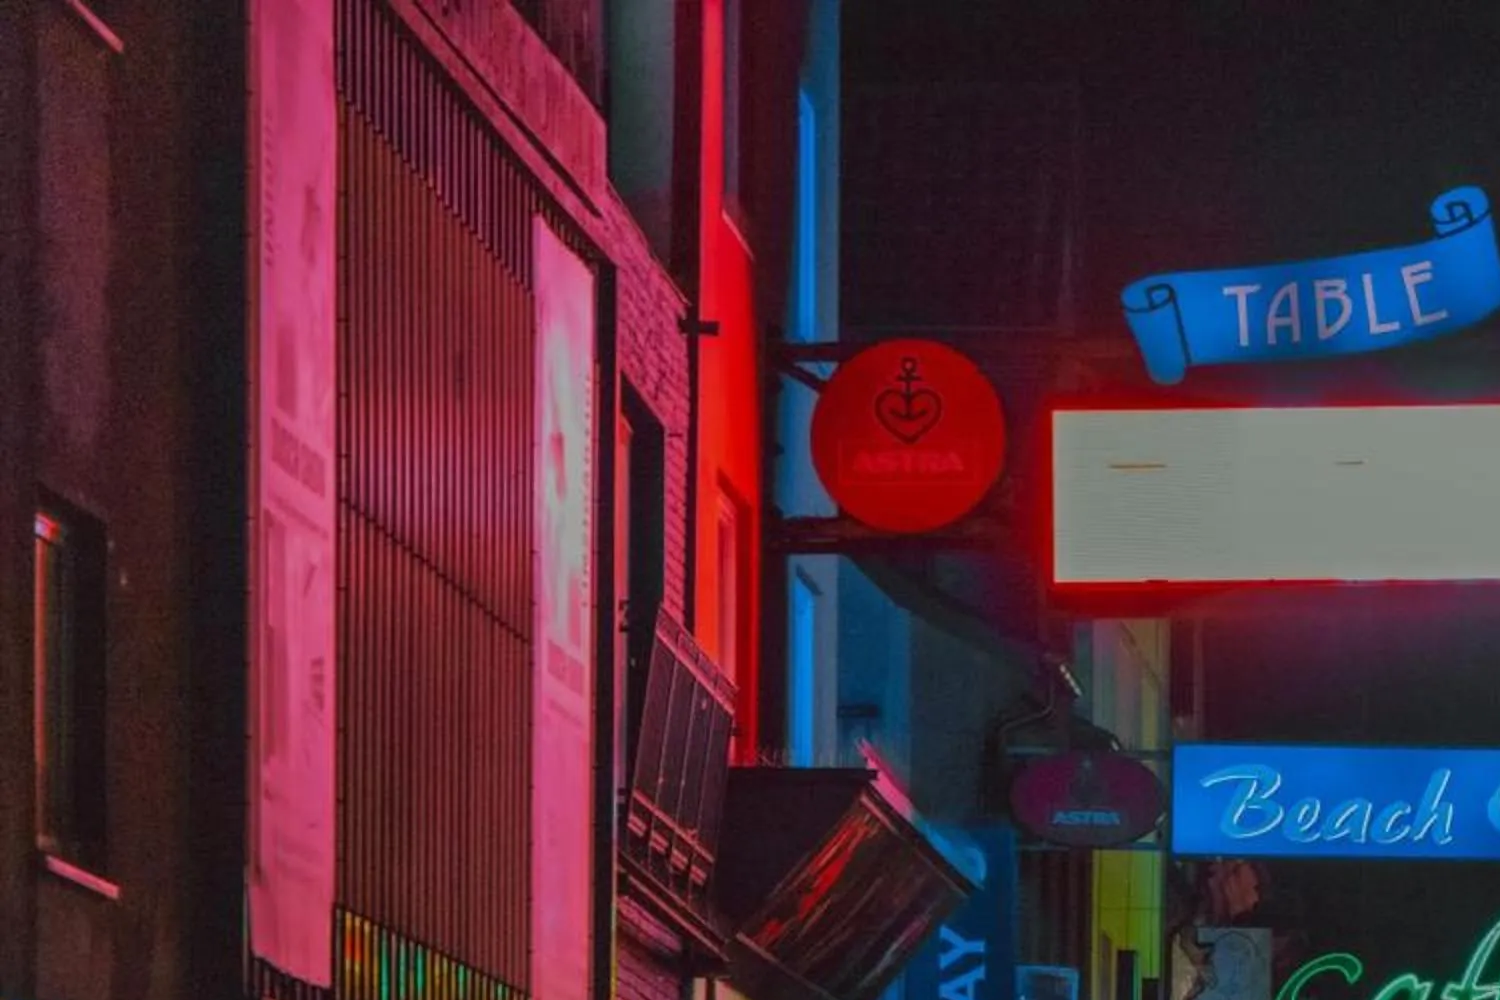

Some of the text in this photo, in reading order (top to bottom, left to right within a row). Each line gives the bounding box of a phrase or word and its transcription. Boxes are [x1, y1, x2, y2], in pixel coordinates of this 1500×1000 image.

[1223, 261, 1449, 346] TABLE
[852, 450, 964, 474] ASTRA
[1051, 809, 1121, 826] ASTRA
[1201, 763, 1453, 845] Beach
